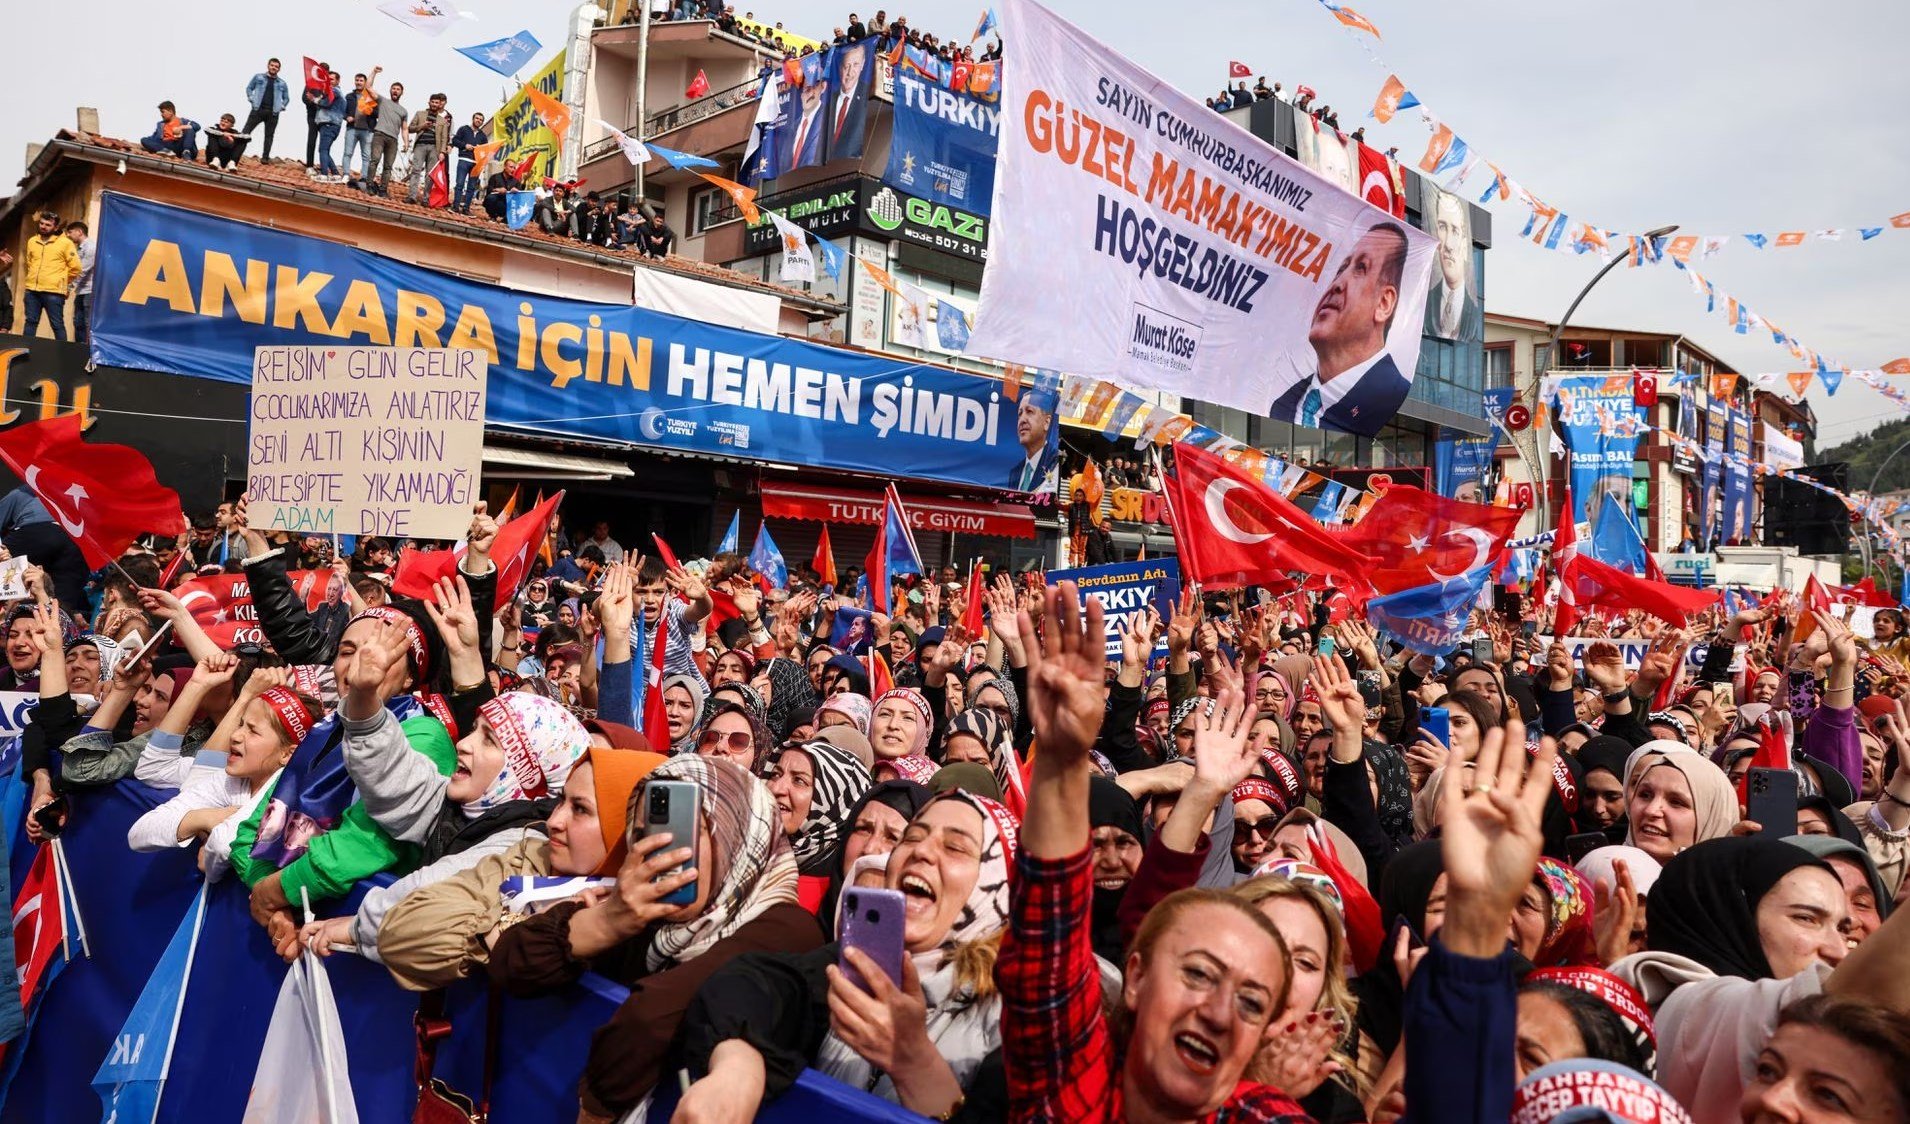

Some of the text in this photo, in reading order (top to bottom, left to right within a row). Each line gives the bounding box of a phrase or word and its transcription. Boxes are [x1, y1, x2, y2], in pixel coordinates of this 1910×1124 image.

[1095, 76, 1313, 212] SAYIN CUMHURBAŞKANIMIZ
[1024, 88, 1333, 283] GÜZEL MAMAK'IMIZA
[789, 189, 856, 219] EMLAK
[808, 209, 850, 230] MÜLK
[935, 235, 959, 250] 507
[962, 243, 976, 256] 31
[1094, 194, 1269, 313] HOŞGELDİNİZ
[119, 238, 499, 365] ANKARA
[516, 301, 653, 389] İÇİN
[666, 343, 863, 425] HEMEN
[869, 374, 1000, 446] ŞİMDİ
[1133, 313, 1196, 359] Murat Köse
[348, 350, 397, 379] GÜN
[408, 349, 478, 381] GELİR
[253, 390, 481, 422] ÇOCUKLARIMIZA ANLATIRIZ
[300, 430, 343, 462] ALTI
[363, 468, 473, 505] YIKAMADIĞI
[929, 508, 985, 531] GİYİM
[1078, 573, 1140, 588] Sevdanın
[1142, 568, 1168, 580] Adı
